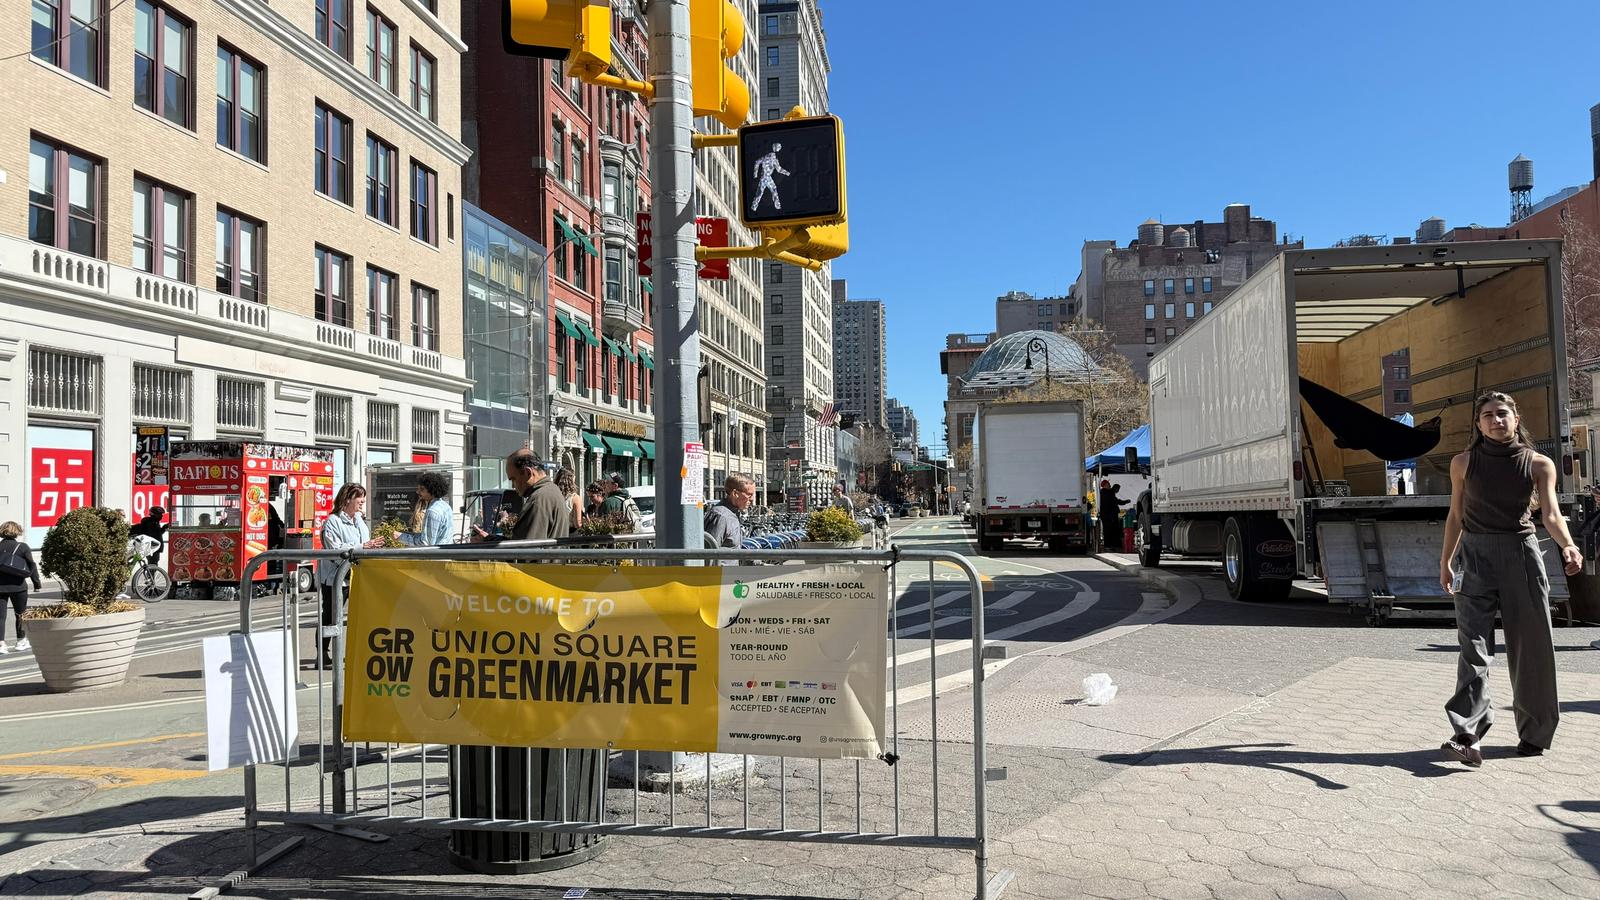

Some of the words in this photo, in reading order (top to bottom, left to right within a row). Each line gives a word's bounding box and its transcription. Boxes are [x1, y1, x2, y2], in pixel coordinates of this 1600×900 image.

[136, 437, 151, 452] $1
[136, 453, 152, 469] $2
[135, 469, 151, 484] $2
[756, 591, 803, 599] SALUDABLE
[446, 595, 571, 616] WELCOME
[584, 598, 616, 617] TO
[729, 617, 751, 625] MON
[758, 617, 784, 625] WEDS
[755, 626, 770, 635] MIÉ
[777, 627, 791, 635] VIE
[798, 626, 815, 634] SÁB
[367, 627, 415, 654] GR
[430, 629, 541, 656] UNION
[553, 632, 697, 661] SQUARE
[730, 653, 753, 661] TODO
[756, 653, 766, 661] EL
[768, 652, 786, 661] AÑO
[366, 656, 414, 682] OW
[428, 656, 697, 705] GREENMARKET
[367, 683, 412, 697] NYC
[729, 694, 754, 702] SNAP
[730, 705, 772, 713] ACCEPTED
[790, 706, 827, 715] ACEPTAN
[729, 731, 802, 743] www.grownyc.org
